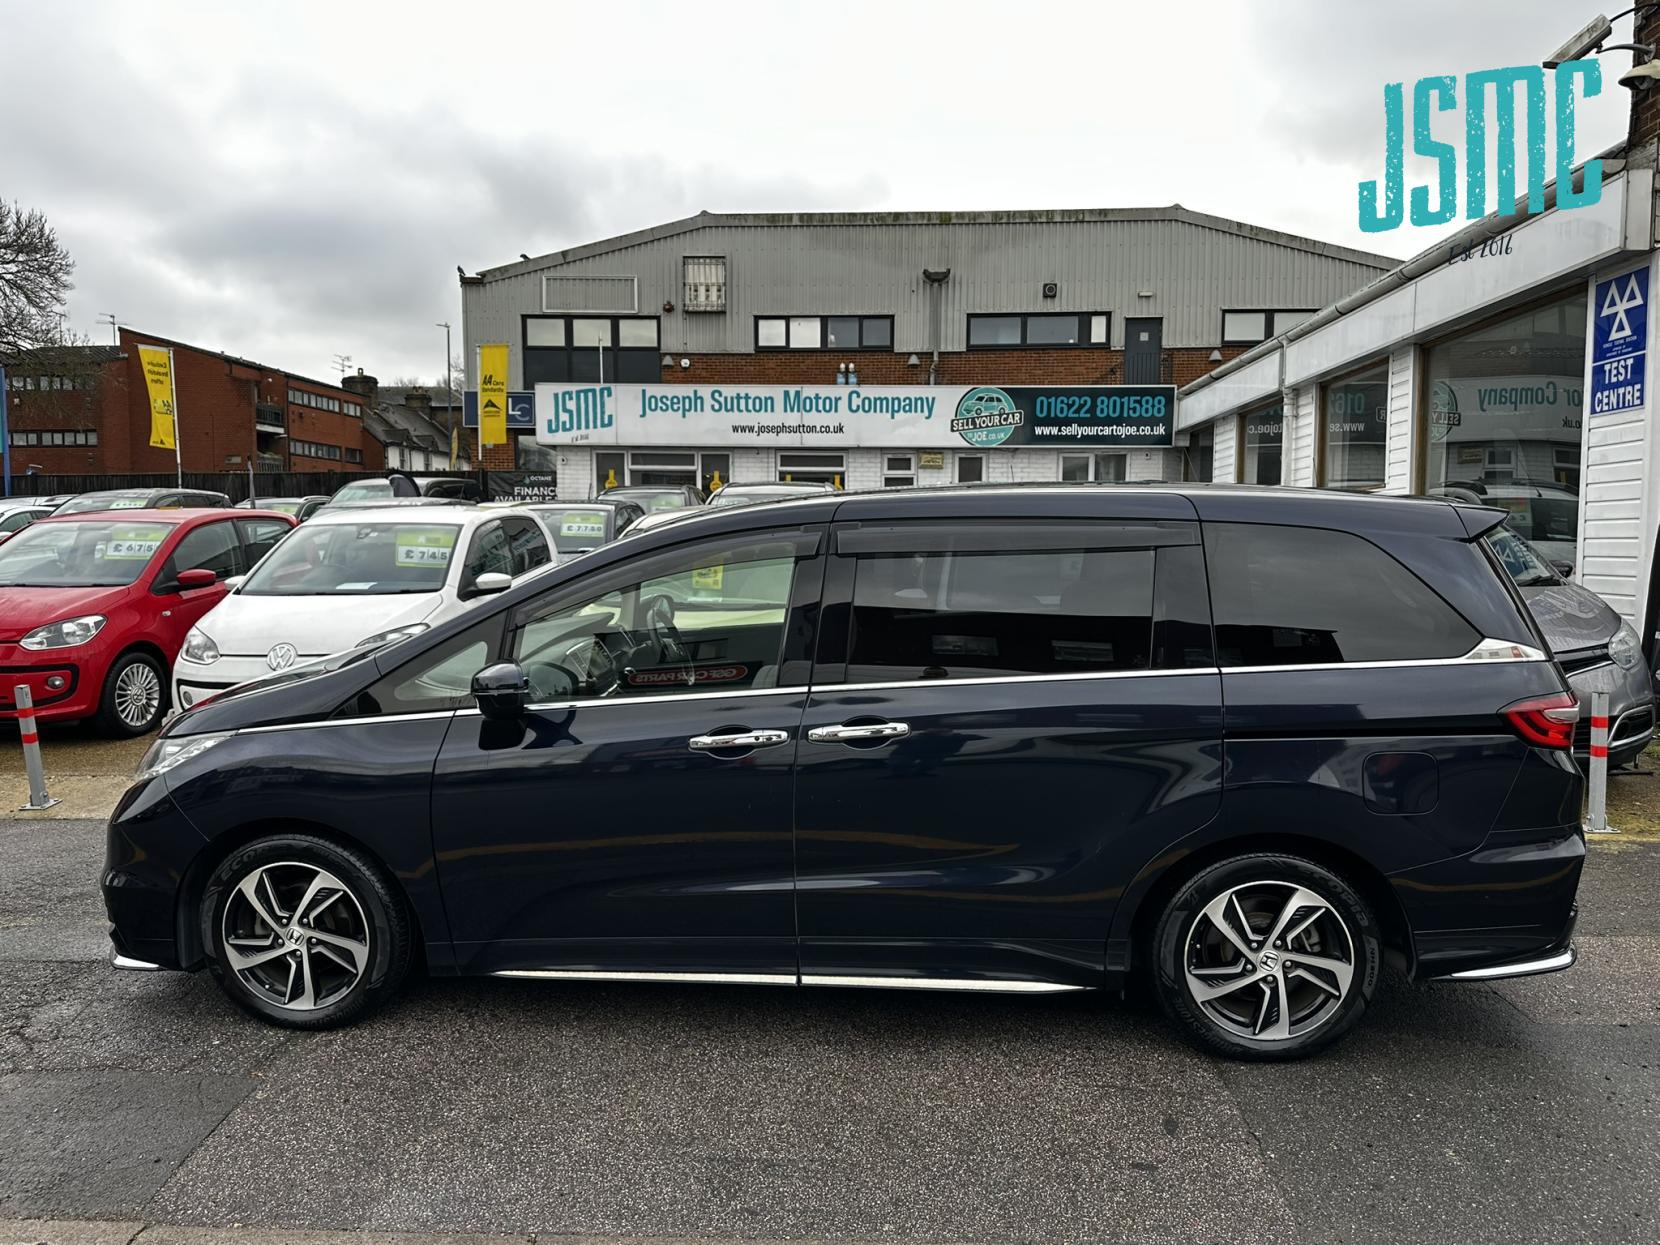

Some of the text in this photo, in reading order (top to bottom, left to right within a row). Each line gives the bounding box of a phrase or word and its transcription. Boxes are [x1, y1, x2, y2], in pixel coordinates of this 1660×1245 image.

[1604, 358, 1634, 384] TEST
[640, 389, 936, 419] Joseph Sutton Motor Company
[1035, 396, 1166, 418] 01622 801588
[1594, 383, 1642, 413] CENTRE
[547, 386, 614, 434] JSMC
[731, 422, 845, 436] www.josephsutton.co.uk
[952, 413, 1020, 431] SELL YOUR CAR
[1034, 422, 1166, 438] www.sellyourcartojoe.co.uk
[514, 486, 558, 496] FINANC
